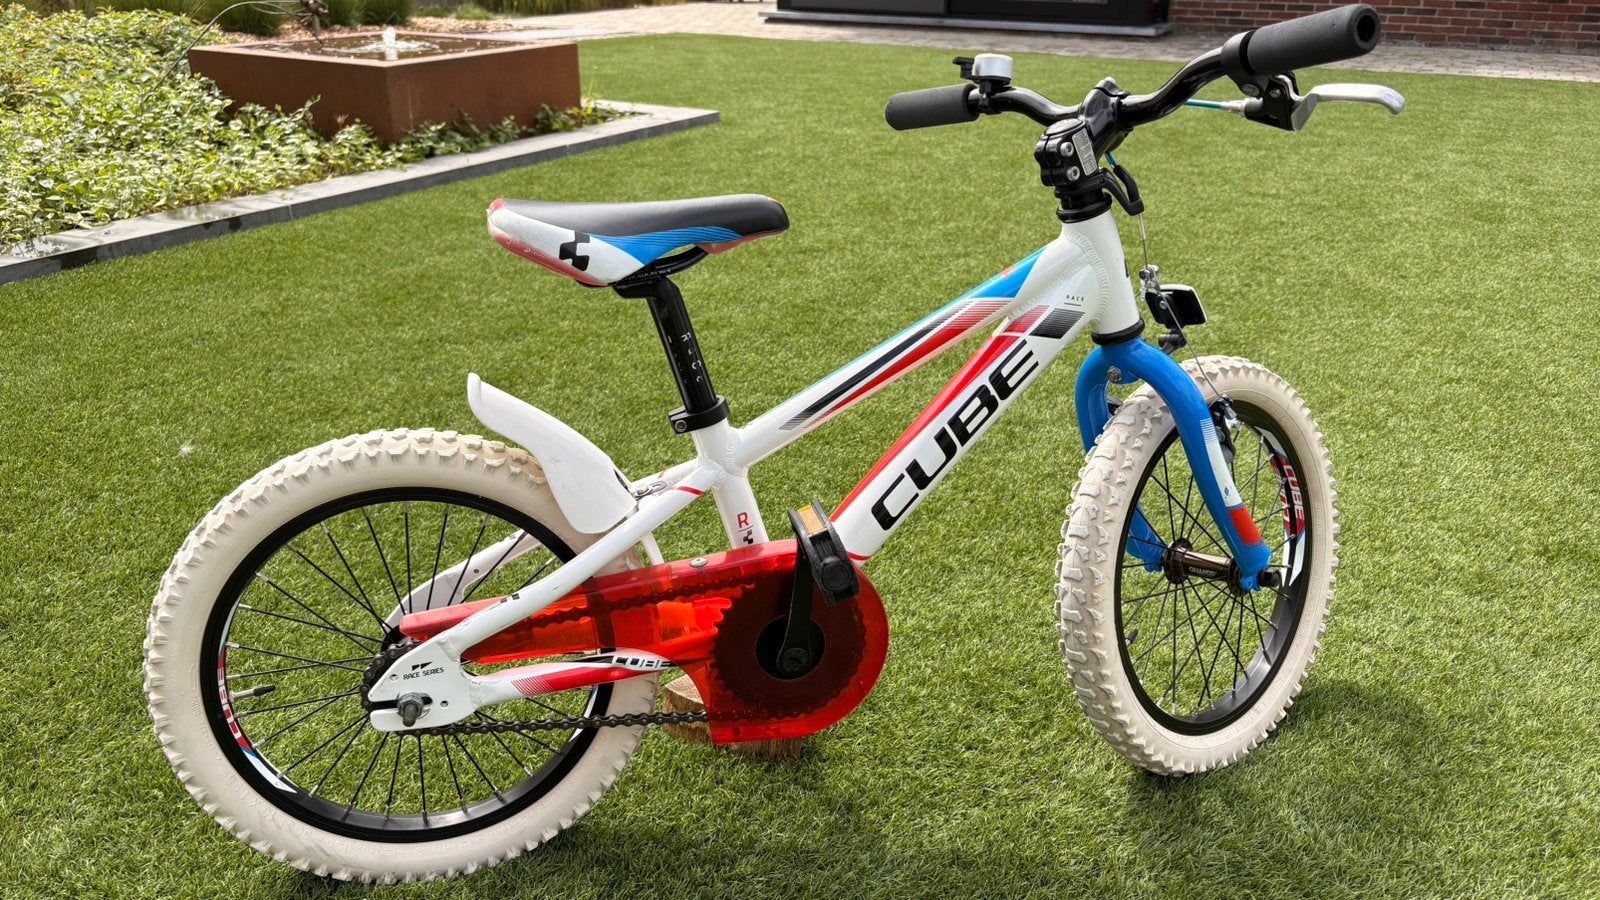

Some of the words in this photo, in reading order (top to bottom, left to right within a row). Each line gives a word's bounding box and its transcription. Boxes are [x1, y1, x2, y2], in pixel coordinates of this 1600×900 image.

[1065, 294, 1085, 302] RACE
[871, 338, 1039, 531] CUBE
[1283, 465, 1305, 521] CUBE
[737, 511, 749, 529] R
[612, 655, 673, 669] CUBE
[403, 671, 421, 680] RACE
[422, 667, 445, 677] SERIES
[217, 667, 241, 740] CUBE
